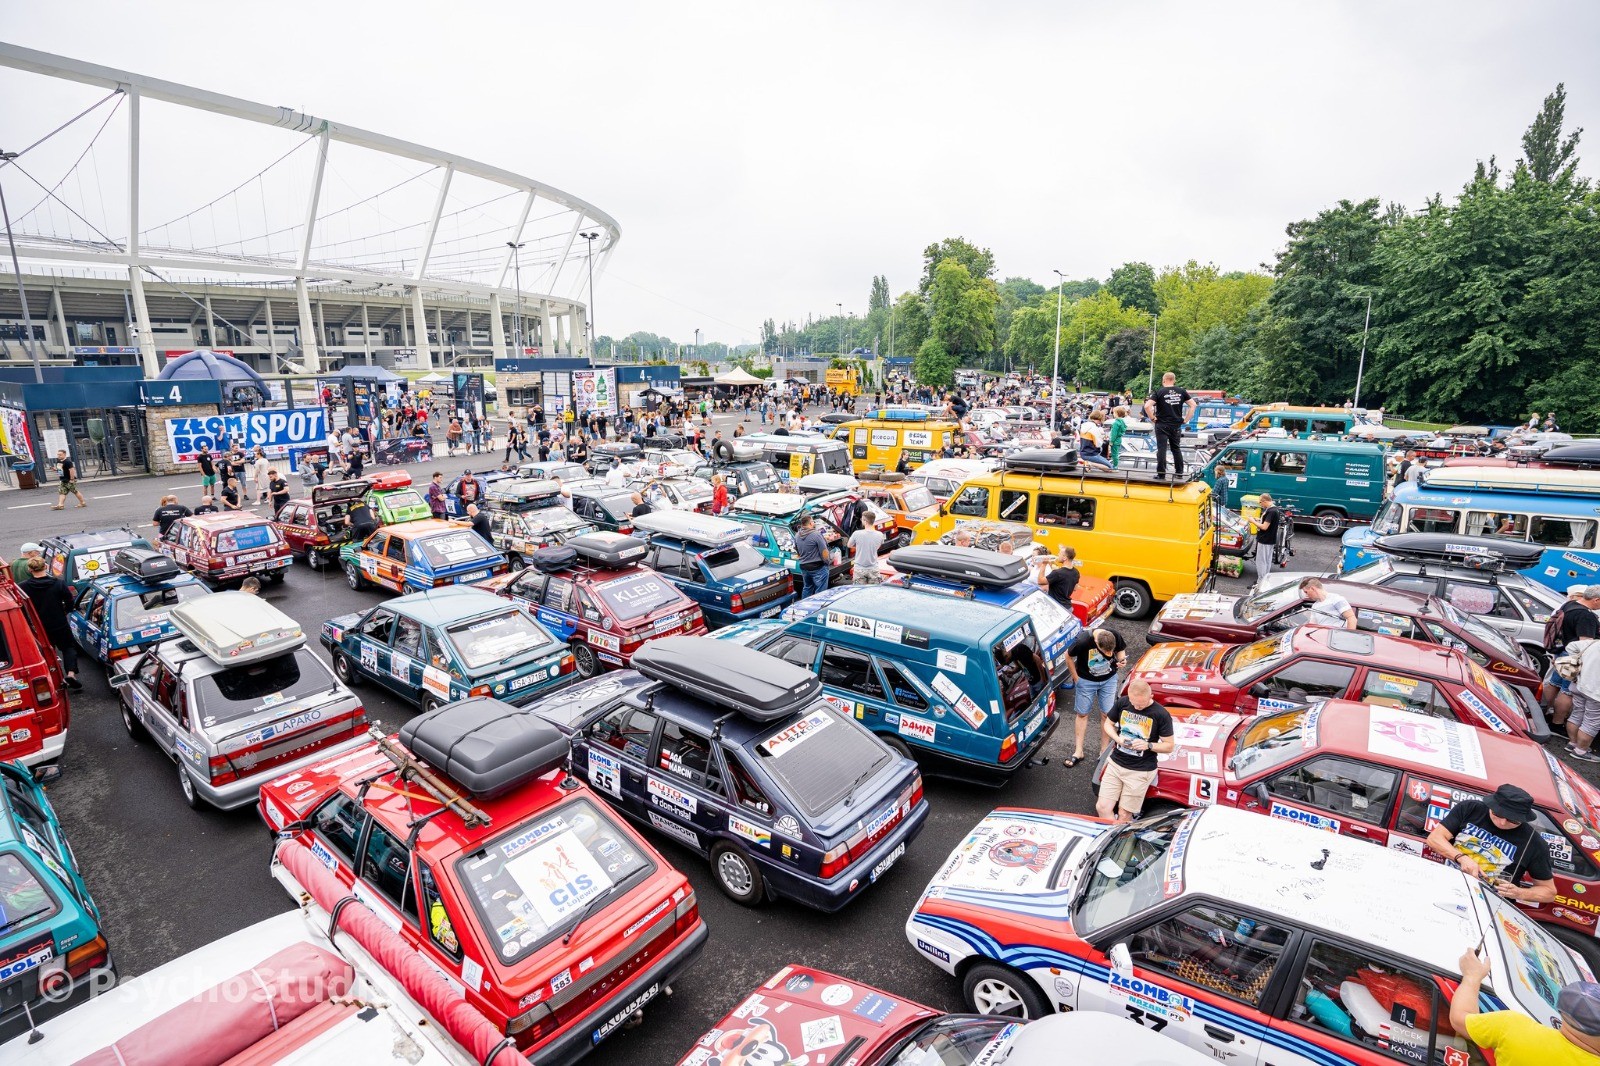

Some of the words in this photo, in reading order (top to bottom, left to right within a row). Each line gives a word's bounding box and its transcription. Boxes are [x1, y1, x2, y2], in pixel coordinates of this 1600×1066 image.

[640, 370, 645, 380] 4
[169, 386, 182, 402] 4
[171, 416, 243, 435] ZŁOM
[251, 411, 321, 445] SPOT
[175, 435, 222, 453] BO
[613, 581, 661, 602] KLEIB
[590, 634, 609, 647] FOTO
[361, 654, 377, 671] 344
[962, 696, 976, 712] BOX
[1259, 698, 1299, 710] ZŁOMB
[274, 709, 322, 734] LAPARO
[901, 719, 935, 737] PAMIR
[769, 720, 809, 749] AUTO
[670, 752, 682, 764] AGA
[669, 762, 692, 779] MARCIN
[595, 772, 613, 791] 55
[649, 780, 682, 797] AUTO
[659, 799, 691, 821] dom-instal
[503, 818, 565, 851] ZŁOMBOL.pl
[650, 812, 696, 839] TRANSPORT
[548, 874, 593, 907] CIS
[918, 940, 949, 961] Unilink
[592, 951, 649, 994] POLONEZ
[554, 977, 571, 992] 383
[1111, 972, 1192, 1011] ZŁOMBOL
[1125, 1004, 1168, 1033] 37
[1393, 1026, 1423, 1041] CYCEK
[1391, 1044, 1422, 1061] KATON
